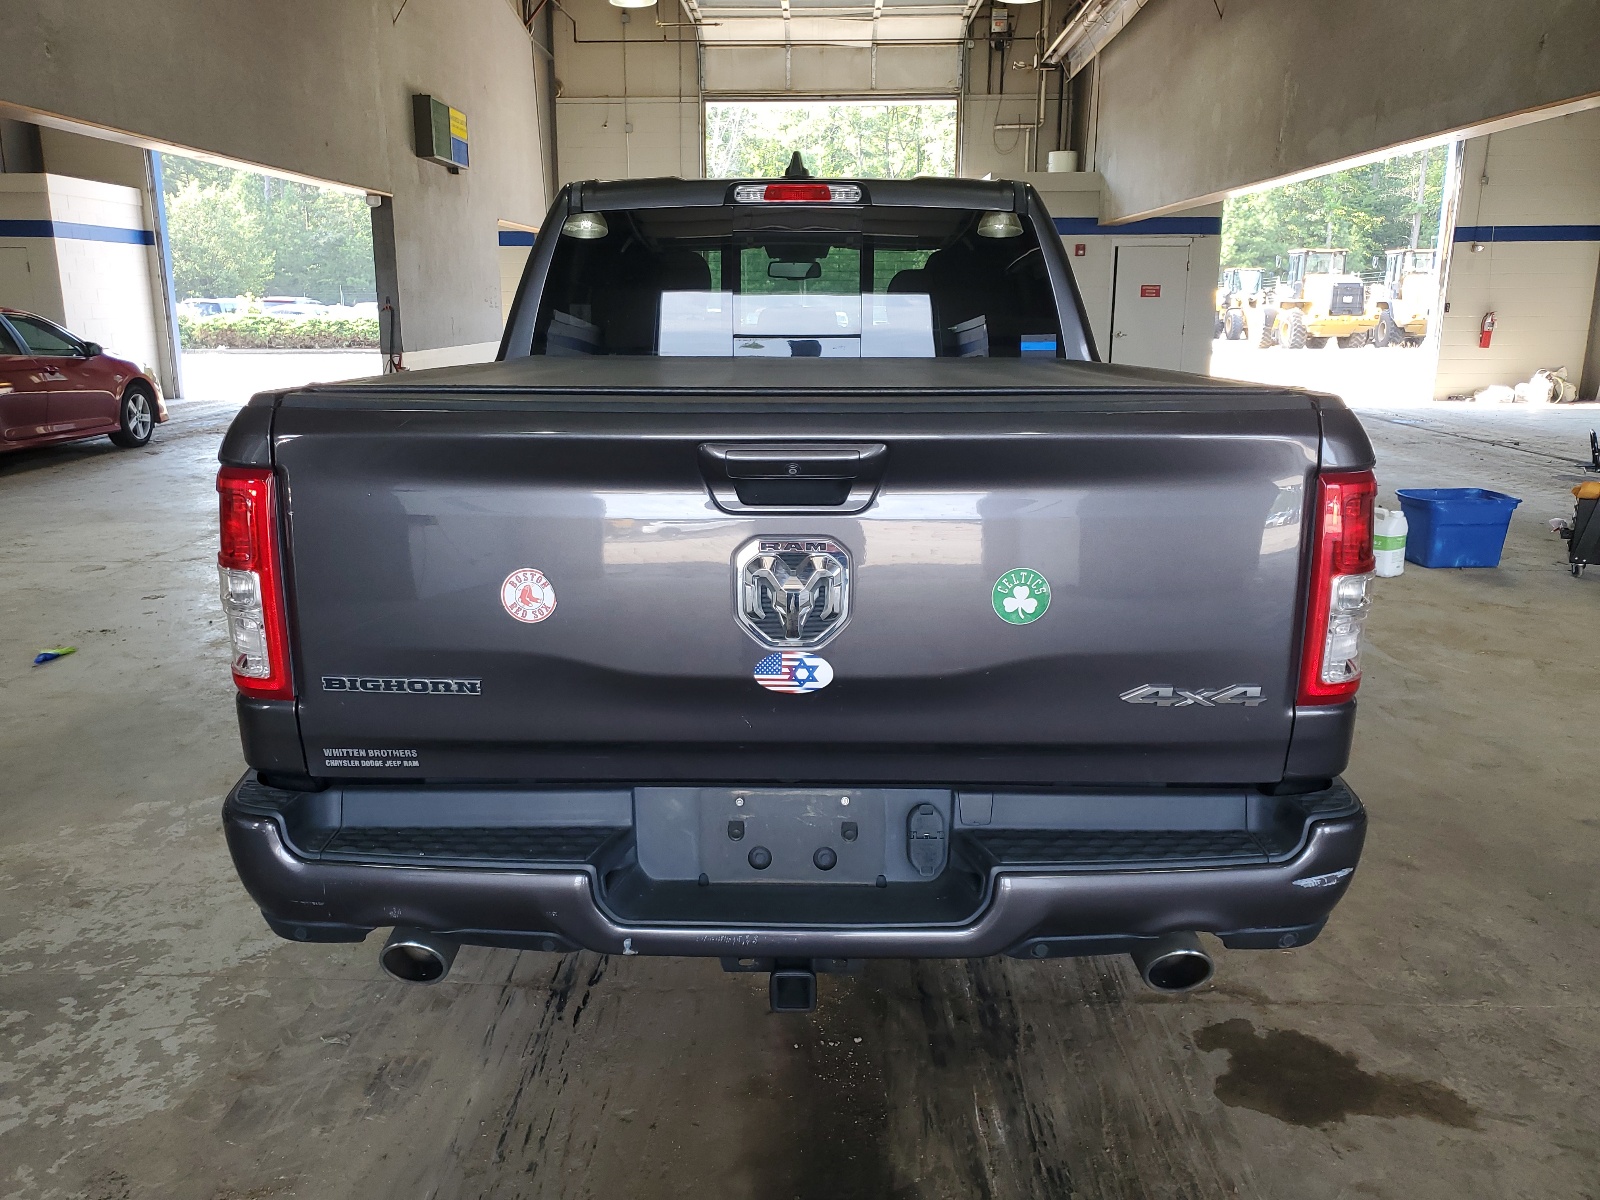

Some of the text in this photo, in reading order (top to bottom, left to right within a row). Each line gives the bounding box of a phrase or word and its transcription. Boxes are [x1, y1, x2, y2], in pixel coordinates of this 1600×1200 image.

[759, 542, 828, 551] RAM
[508, 572, 550, 589] BOSTON
[997, 571, 1047, 595] CELTICS
[508, 602, 551, 619] RED SOX
[321, 676, 482, 695] BIGHORN
[323, 748, 418, 758] WHITTEN BROTHERS
